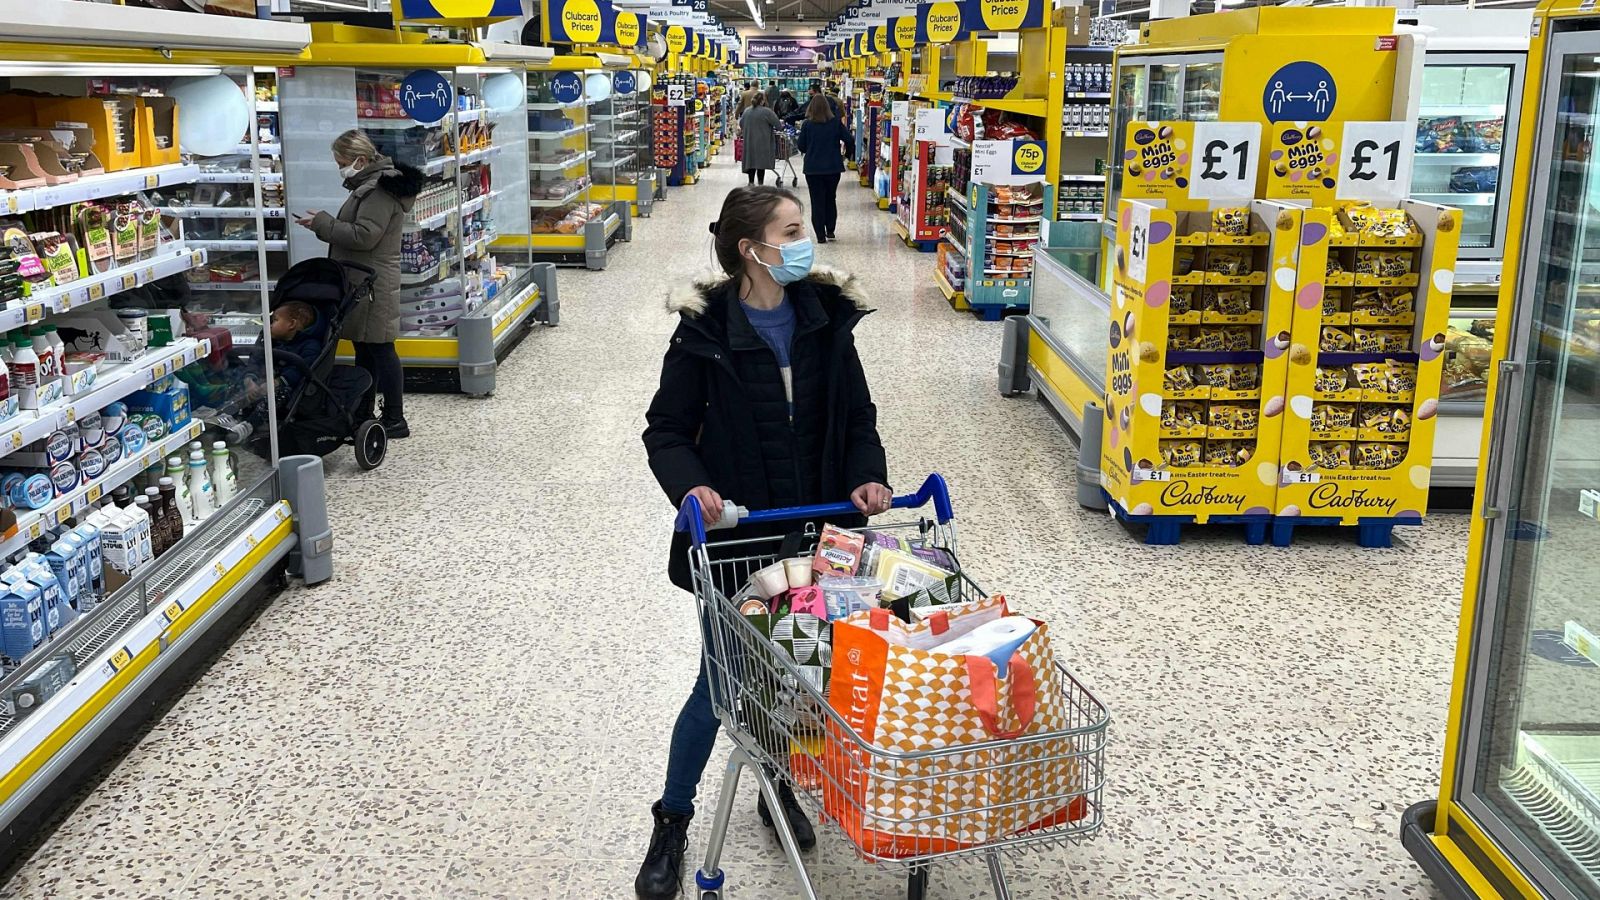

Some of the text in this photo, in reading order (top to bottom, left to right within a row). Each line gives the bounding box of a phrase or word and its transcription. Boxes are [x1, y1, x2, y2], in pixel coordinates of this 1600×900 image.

[694, 0, 706, 10] 26
[991, 5, 1019, 16] Prices
[565, 11, 599, 22] Clubcard
[669, 9, 690, 17] Poultry
[848, 7, 859, 17] 10
[706, 16, 716, 24] 25
[839, 15, 846, 24] 11
[929, 14, 958, 23] Clubcard
[571, 23, 594, 32] Prices
[617, 21, 638, 30] Clubcard
[933, 24, 953, 32] Prices
[620, 29, 635, 38] Prices
[751, 45, 799, 53] Health & Beauty
[669, 89, 683, 101] £2
[1020, 148, 1040, 160] 75p
[1141, 140, 1172, 159] Mini
[1288, 140, 1320, 160] Mini
[1142, 152, 1176, 169] eggs
[1200, 140, 1249, 180] £1
[1289, 152, 1324, 169] eggs
[1348, 140, 1401, 181] £1
[974, 168, 983, 176] £1
[1132, 224, 1147, 260] £1
[1112, 349, 1130, 374] Mini
[1112, 373, 1132, 395] eggs
[1150, 471, 1162, 480] £1
[1300, 473, 1312, 482] £1
[1160, 480, 1246, 511] Cadbury
[1308, 482, 1398, 515] Cadbury
[140, 529, 150, 541] LY!
[126, 536, 136, 550] LY!
[90, 546, 100, 560] LY!
[824, 550, 853, 563] Actimel
[68, 566, 78, 580] LY!
[48, 594, 59, 610] LY!
[30, 607, 42, 622] LY!
